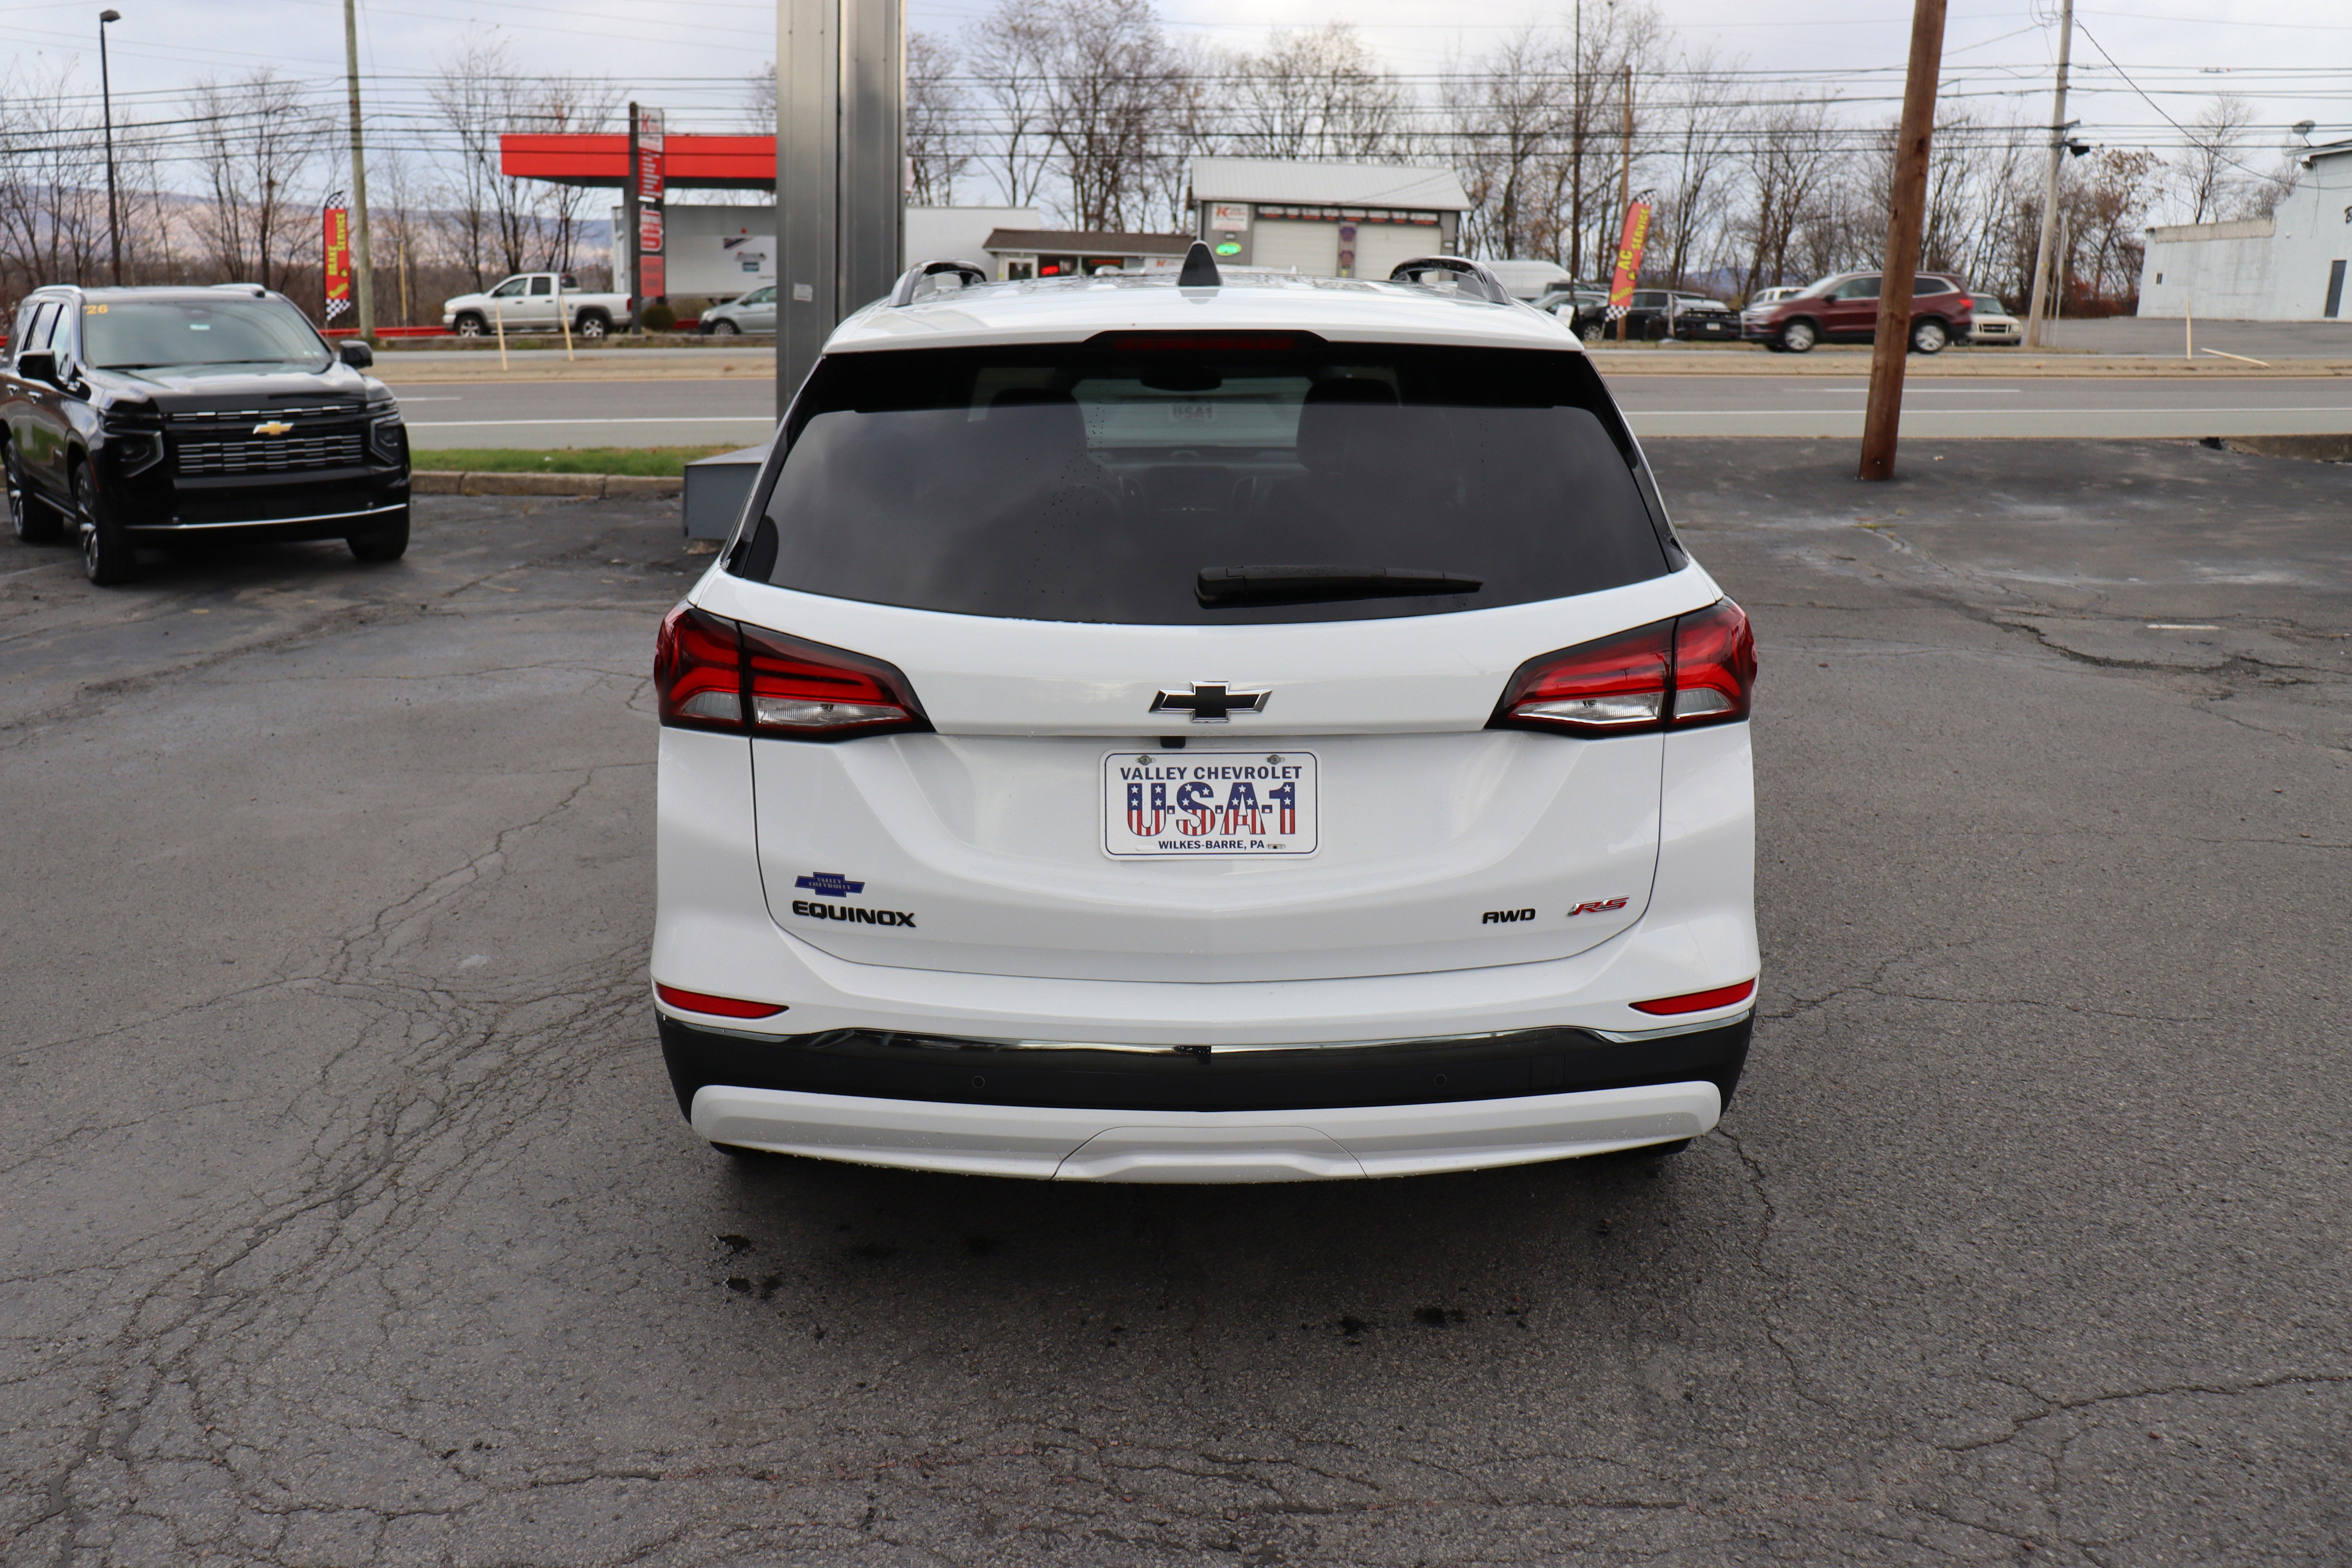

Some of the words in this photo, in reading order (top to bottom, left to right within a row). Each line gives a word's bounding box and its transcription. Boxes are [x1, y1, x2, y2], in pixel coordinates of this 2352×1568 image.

[1632, 207, 1650, 250] SERVICE
[1617, 249, 1633, 271] AC
[1120, 767, 1187, 780] VALLEY
[1194, 766, 1302, 780] CHEVROLET
[1158, 840, 1247, 850] WILKES-BARRE,
[1250, 840, 1265, 849] PA
[808, 882, 851, 890] CHEVROLET
[793, 900, 916, 927] EQUINOX
[1482, 908, 1536, 924] AWD
[1566, 895, 1630, 917] RS
